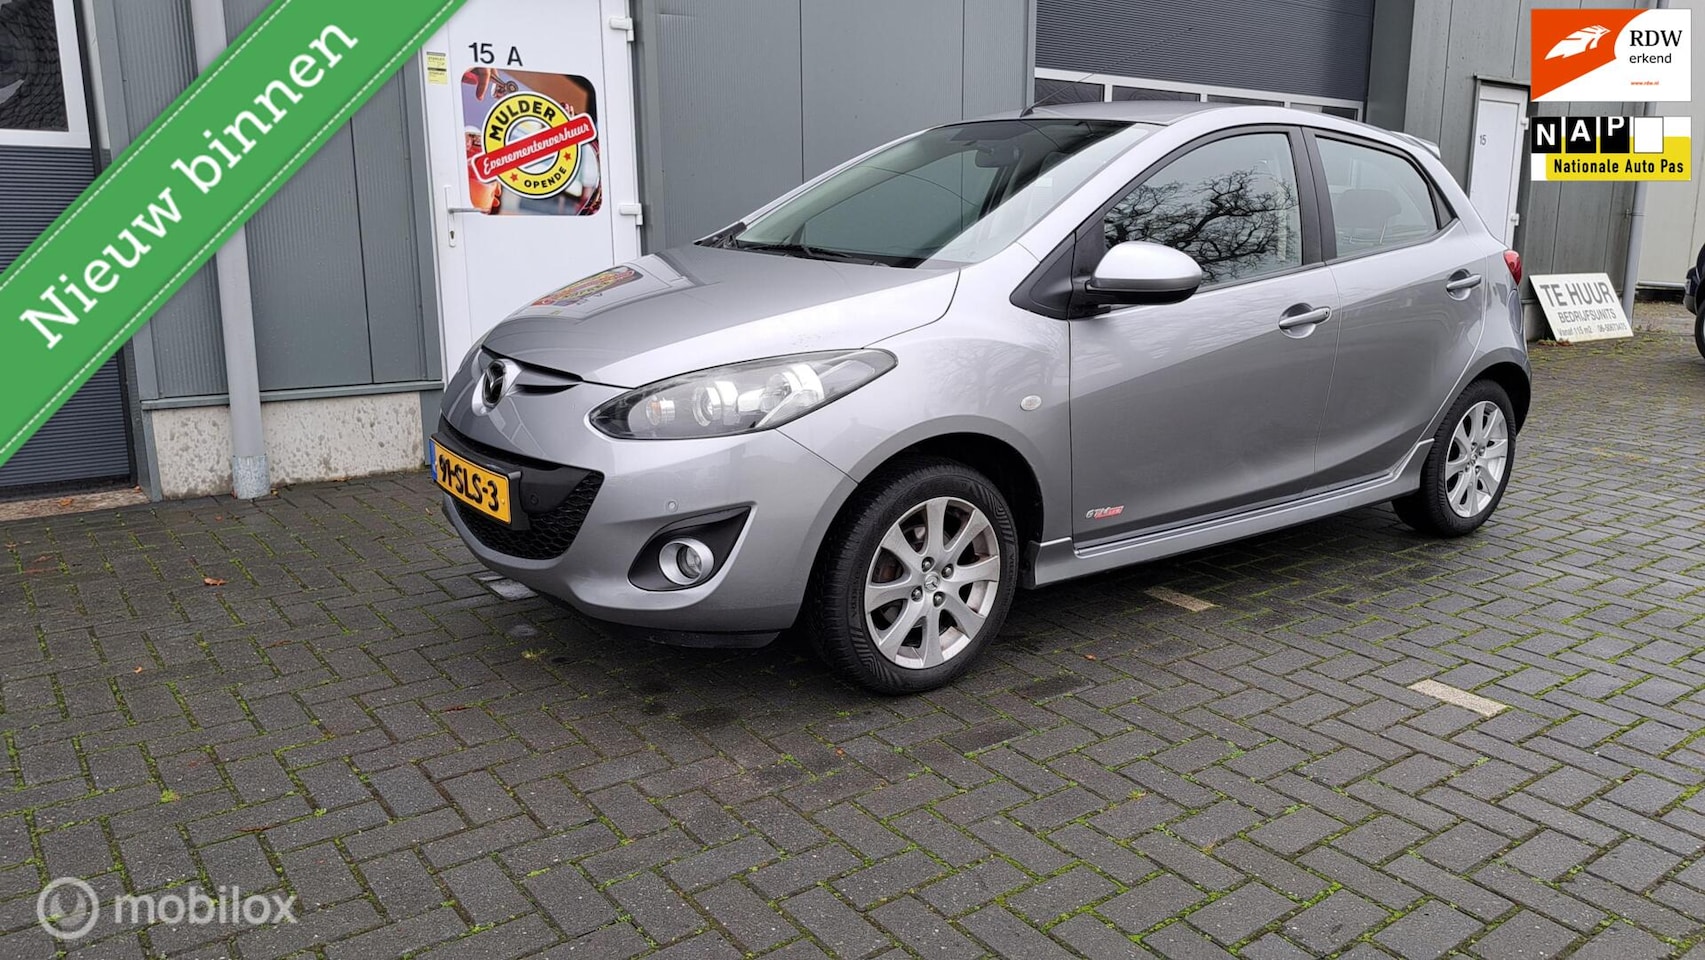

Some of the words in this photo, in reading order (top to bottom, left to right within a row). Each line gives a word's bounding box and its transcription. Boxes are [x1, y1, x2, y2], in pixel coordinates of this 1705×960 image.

[468, 42, 495, 64] 15
[507, 46, 523, 67] A
[489, 100, 557, 141] MULDER
[483, 122, 590, 174] Evenementenverhuur
[1479, 134, 1487, 146] 15
[524, 166, 567, 189] OPENDE
[1539, 283, 1568, 307] TE
[1565, 282, 1615, 306] HUUR
[1557, 308, 1617, 323] BEDRIJFSUNITS
[438, 454, 499, 512] 91-SLS-3
